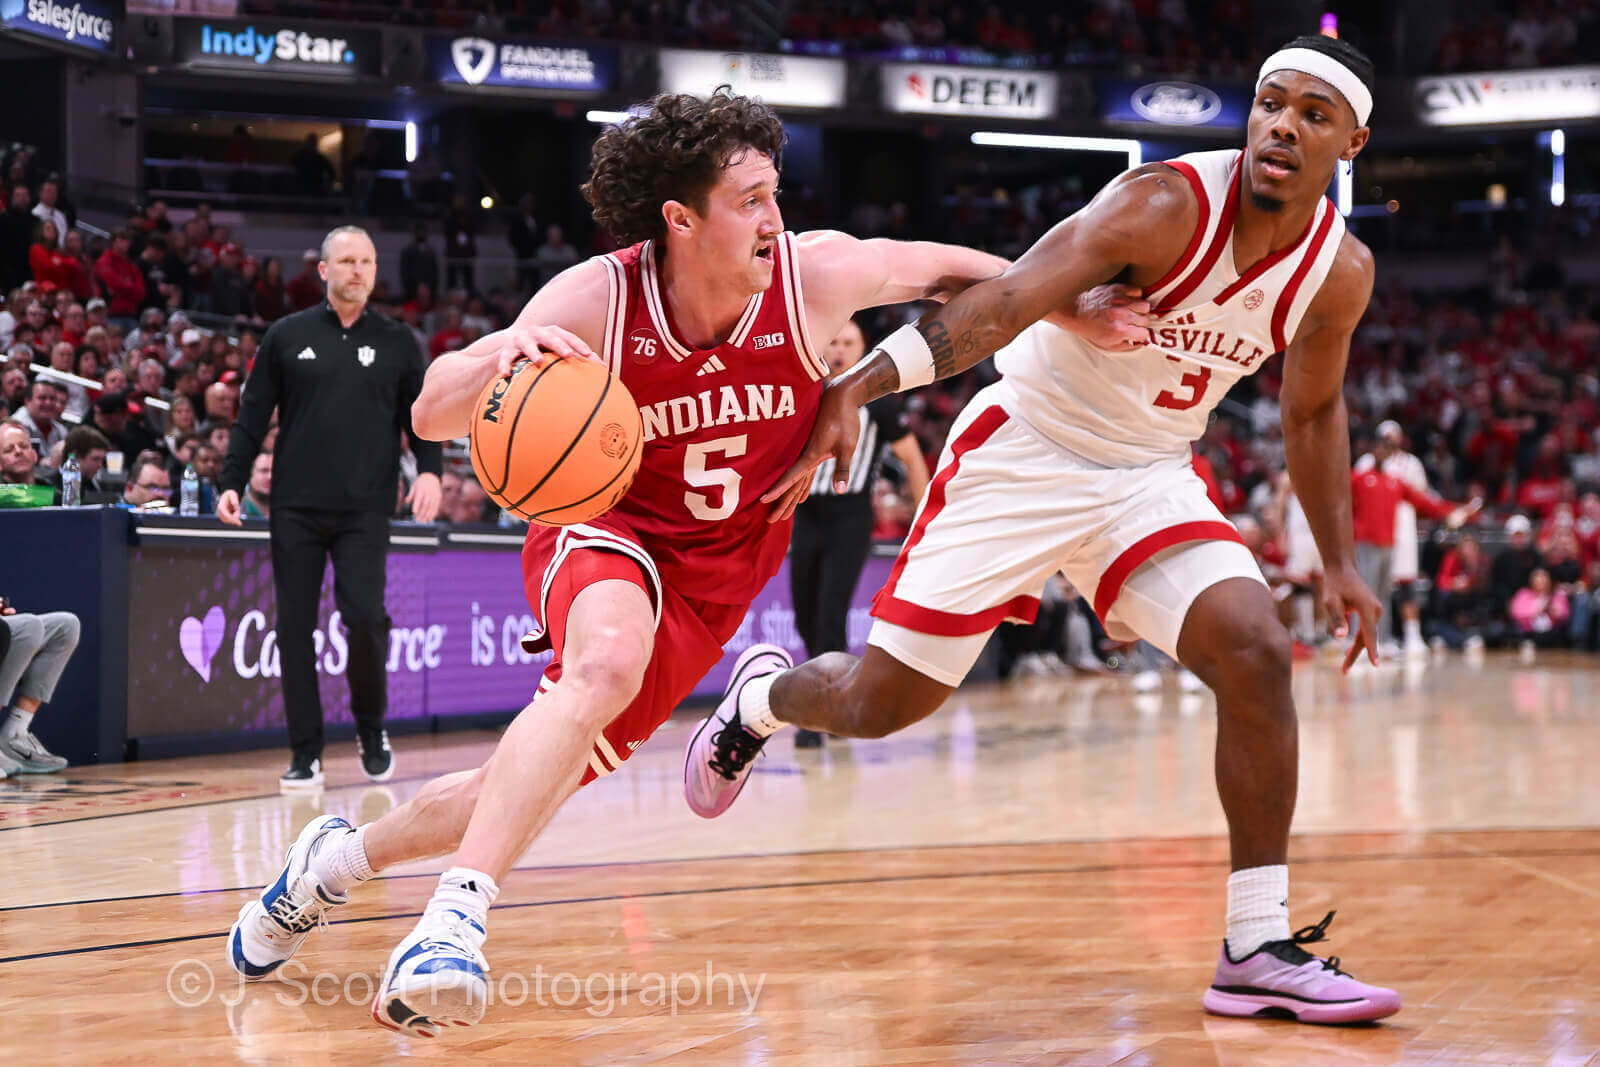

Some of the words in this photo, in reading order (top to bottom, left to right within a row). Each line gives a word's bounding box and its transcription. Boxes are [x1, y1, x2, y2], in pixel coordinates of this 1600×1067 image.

[27, 0, 112, 41] salesforce
[932, 76, 1036, 106] DEEM
[1153, 355, 1212, 411] 3
[640, 384, 796, 442] NDIANA
[683, 433, 748, 521] 5
[471, 601, 496, 667] is
